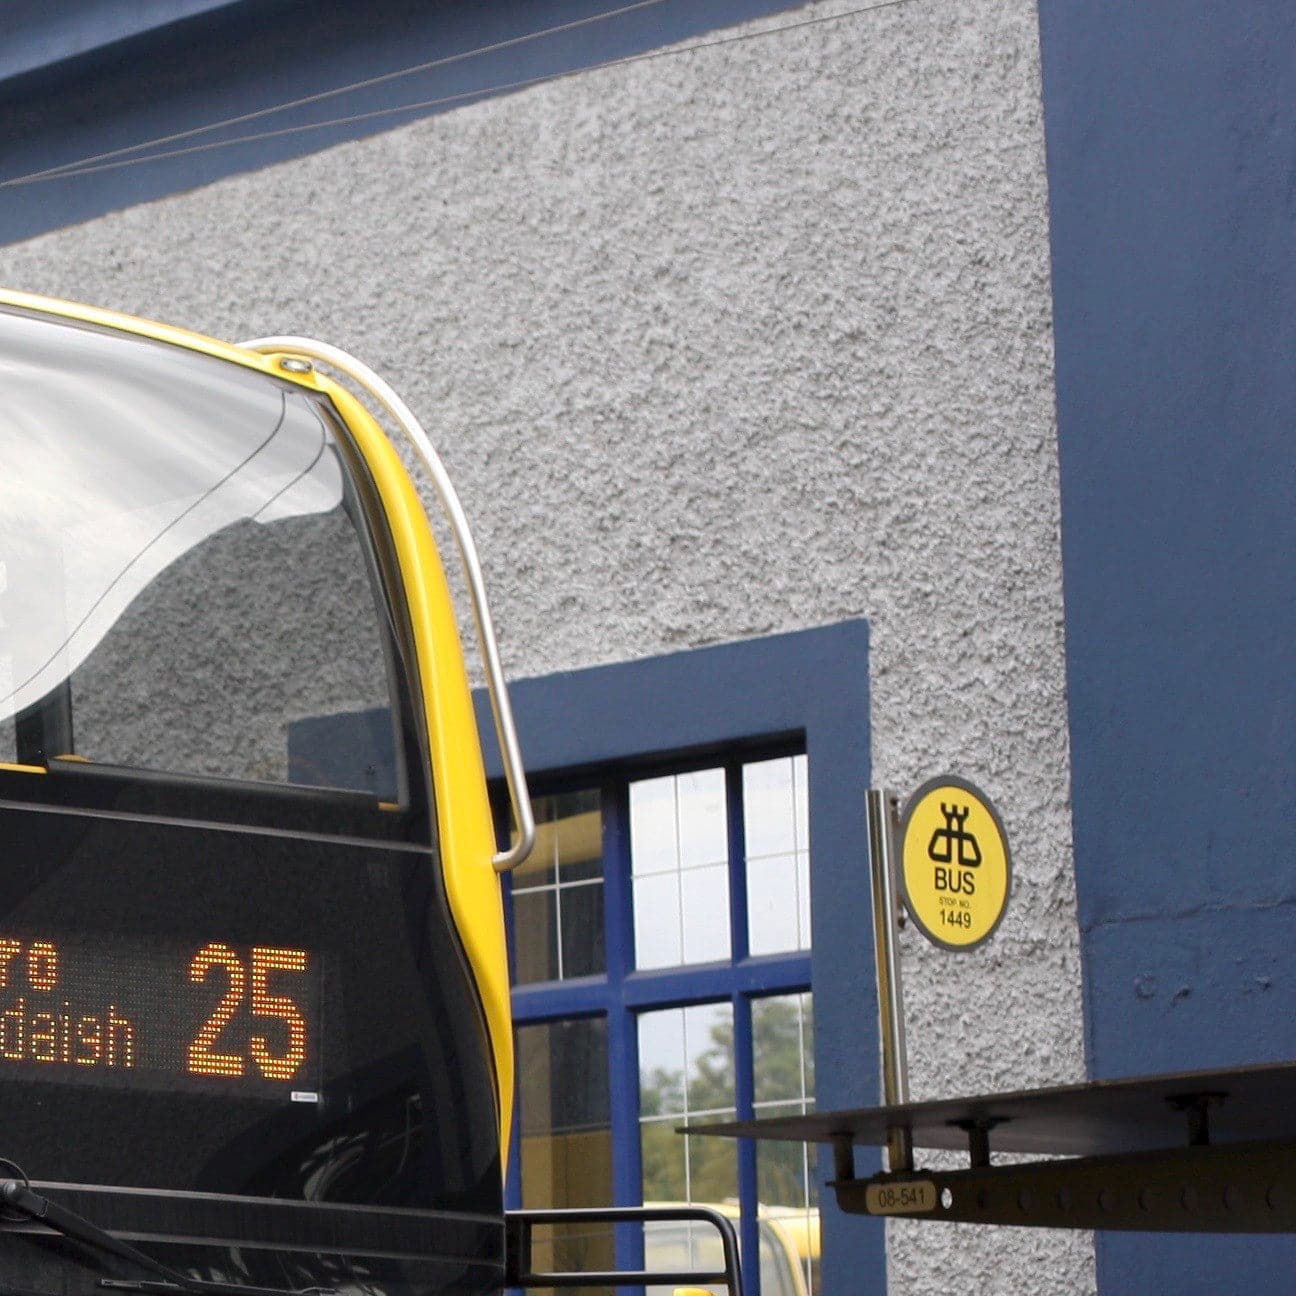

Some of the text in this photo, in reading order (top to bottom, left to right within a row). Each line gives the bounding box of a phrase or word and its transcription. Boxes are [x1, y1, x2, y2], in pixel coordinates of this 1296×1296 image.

[934, 866, 975, 895] BUS
[940, 909, 971, 929] 1449
[188, 941, 307, 1080] 25
